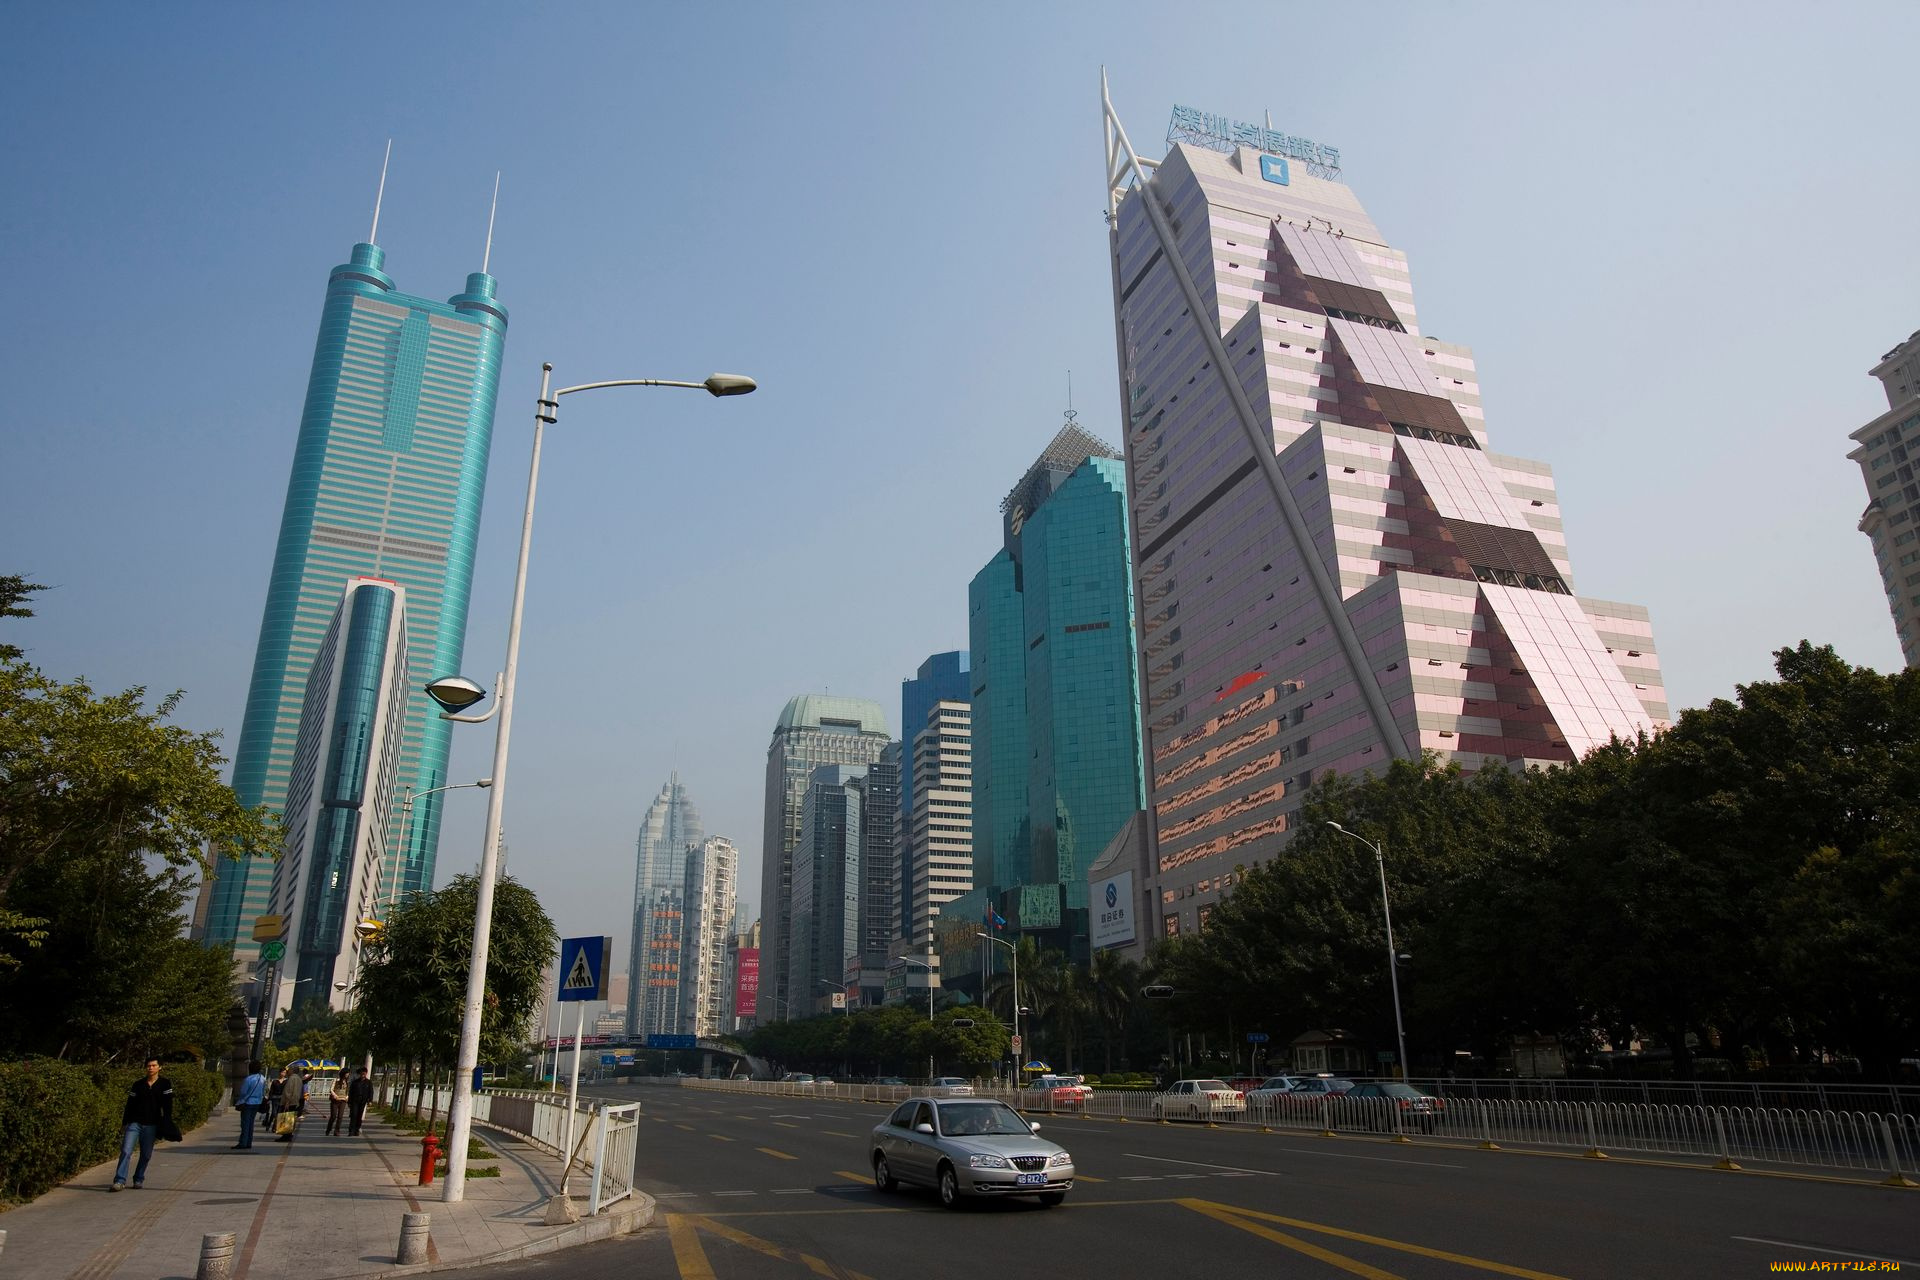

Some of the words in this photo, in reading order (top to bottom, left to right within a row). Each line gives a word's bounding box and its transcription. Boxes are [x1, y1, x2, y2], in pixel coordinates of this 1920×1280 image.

[1174, 104, 1341, 169] 深圳发展银行
